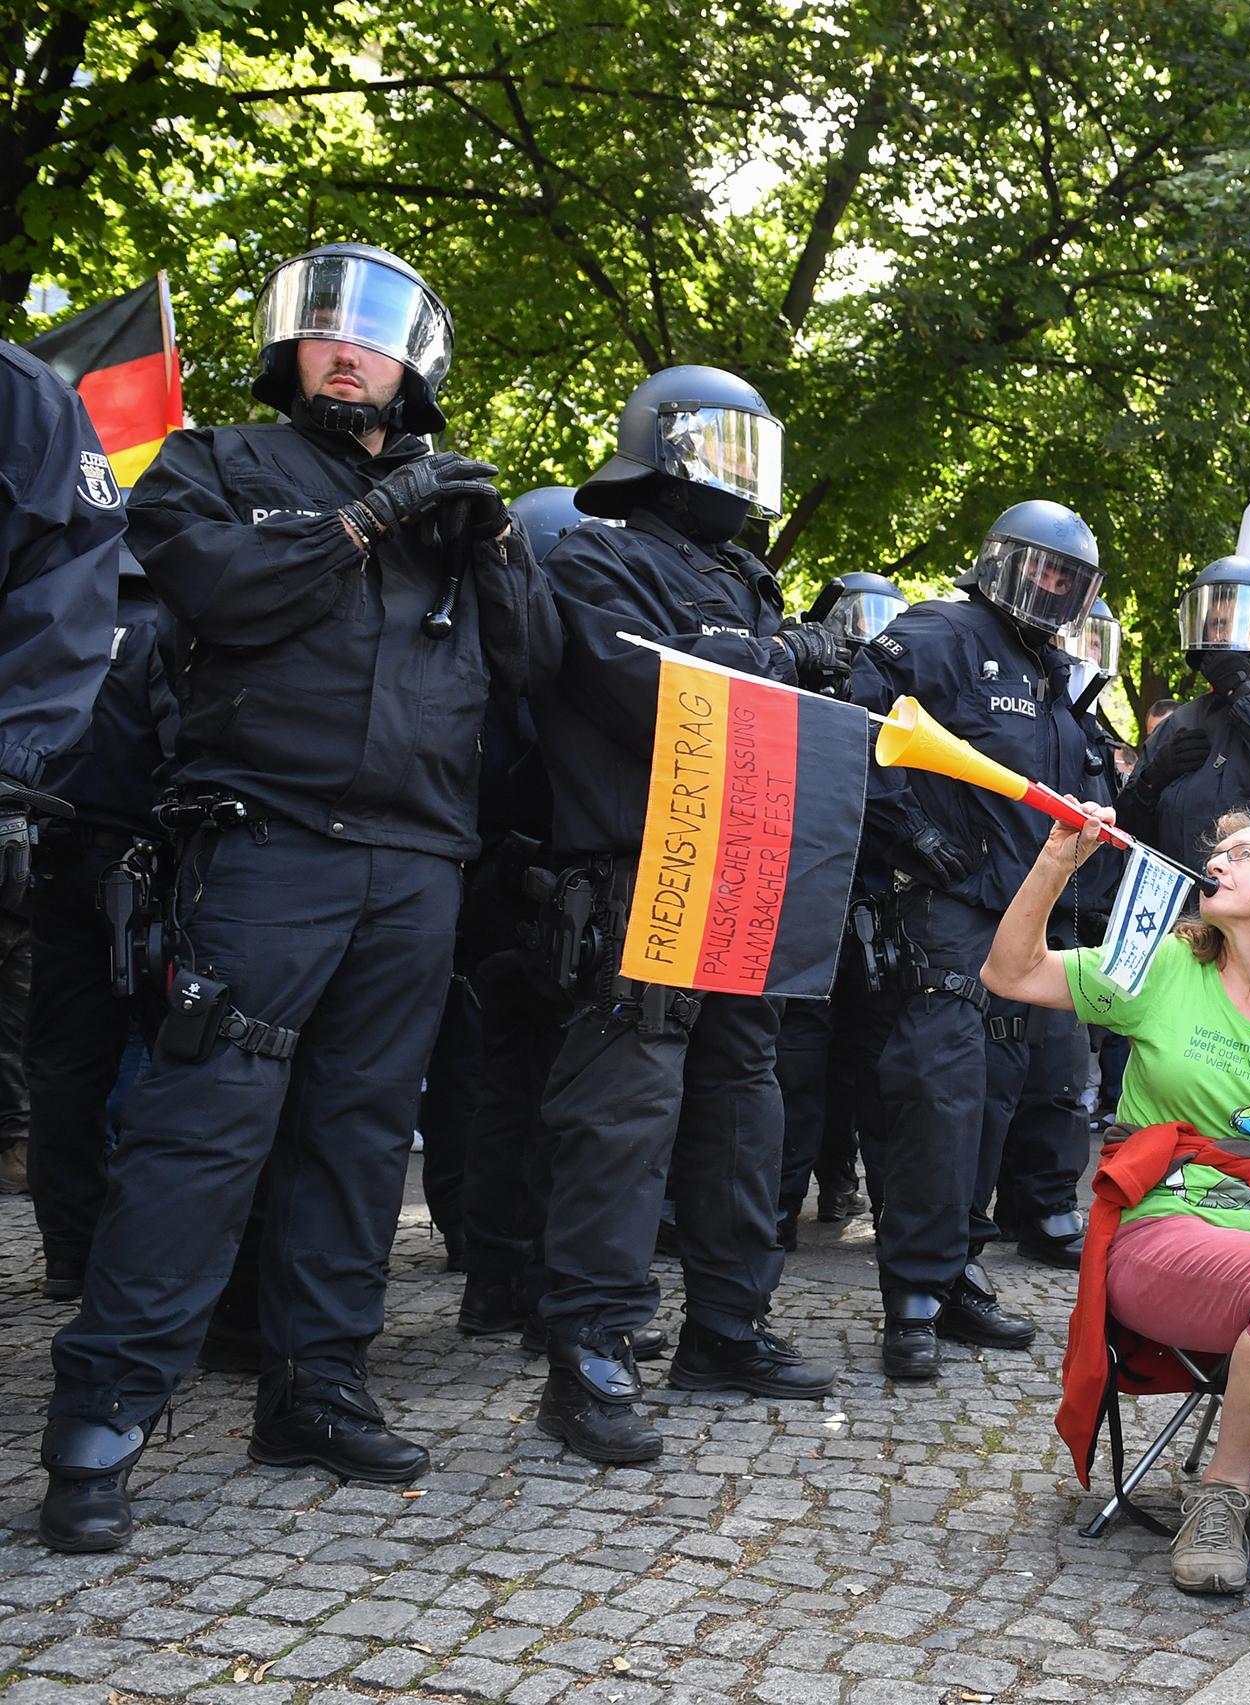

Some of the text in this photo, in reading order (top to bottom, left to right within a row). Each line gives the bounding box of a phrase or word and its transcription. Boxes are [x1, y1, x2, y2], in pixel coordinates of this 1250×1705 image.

[876, 635, 903, 655] BFE
[991, 696, 1036, 717] POLIZEI
[645, 692, 713, 964] FRIEDENS-VERTRAG
[703, 706, 758, 975] PAULSKIRCHEN-VERFASSUNG
[739, 770, 793, 980] HAMBACHER FEST
[1195, 1025, 1250, 1053] Verändern
[1183, 1048, 1202, 1061] die
[1218, 1048, 1245, 1063] oder
